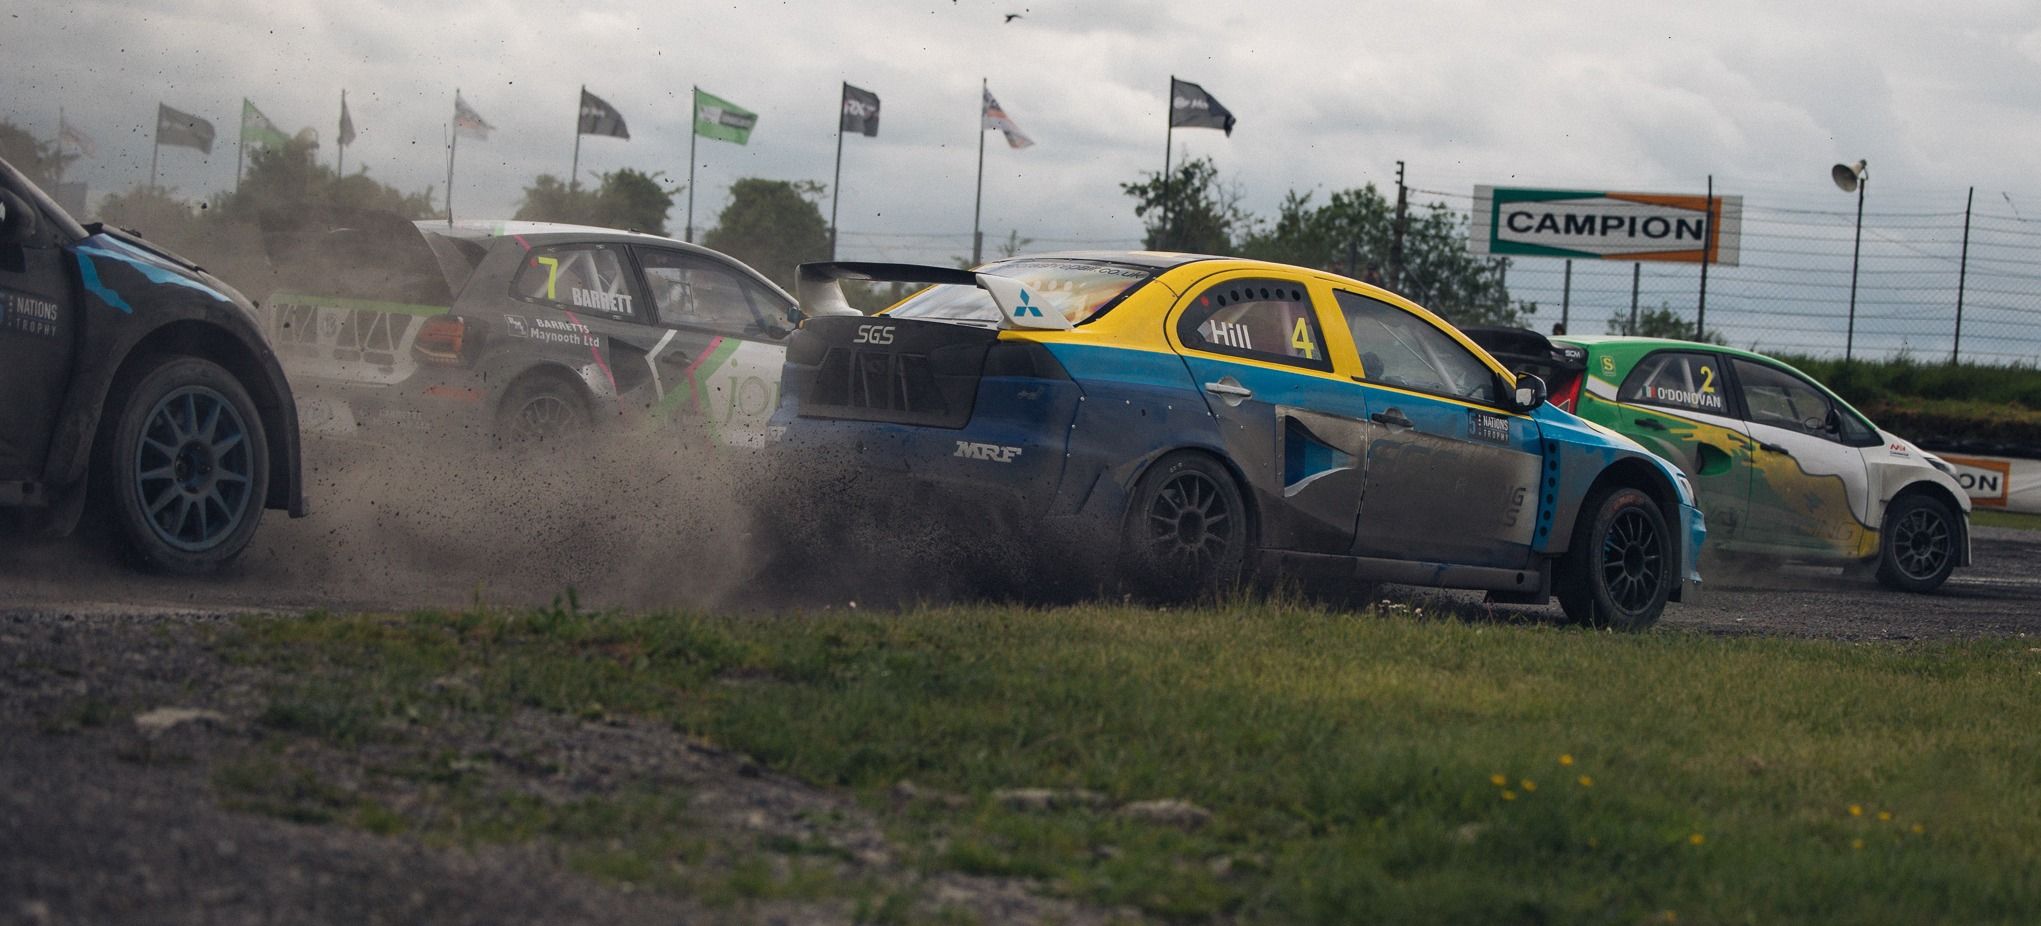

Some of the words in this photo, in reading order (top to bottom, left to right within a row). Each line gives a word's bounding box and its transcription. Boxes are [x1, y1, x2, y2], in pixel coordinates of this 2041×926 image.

[1507, 211, 1704, 240] CAMPION
[538, 256, 558, 299] 7
[16, 296, 57, 321] NATIONS
[572, 287, 632, 314] BARRETT
[16, 318, 57, 337] TROPHY
[530, 328, 580, 345] Maynooth
[584, 337, 600, 347] Ltd
[536, 319, 591, 334] BARRETTS
[853, 324, 896, 345] SGS
[1210, 320, 1252, 350] Hill
[1291, 317, 1314, 359] 4
[1700, 366, 1715, 393] 2
[1657, 387, 1721, 408] O'DONOVAN
[1483, 415, 1509, 431] NATIONS
[1483, 429, 1509, 441] TROPHY
[953, 440, 1022, 463] MRF
